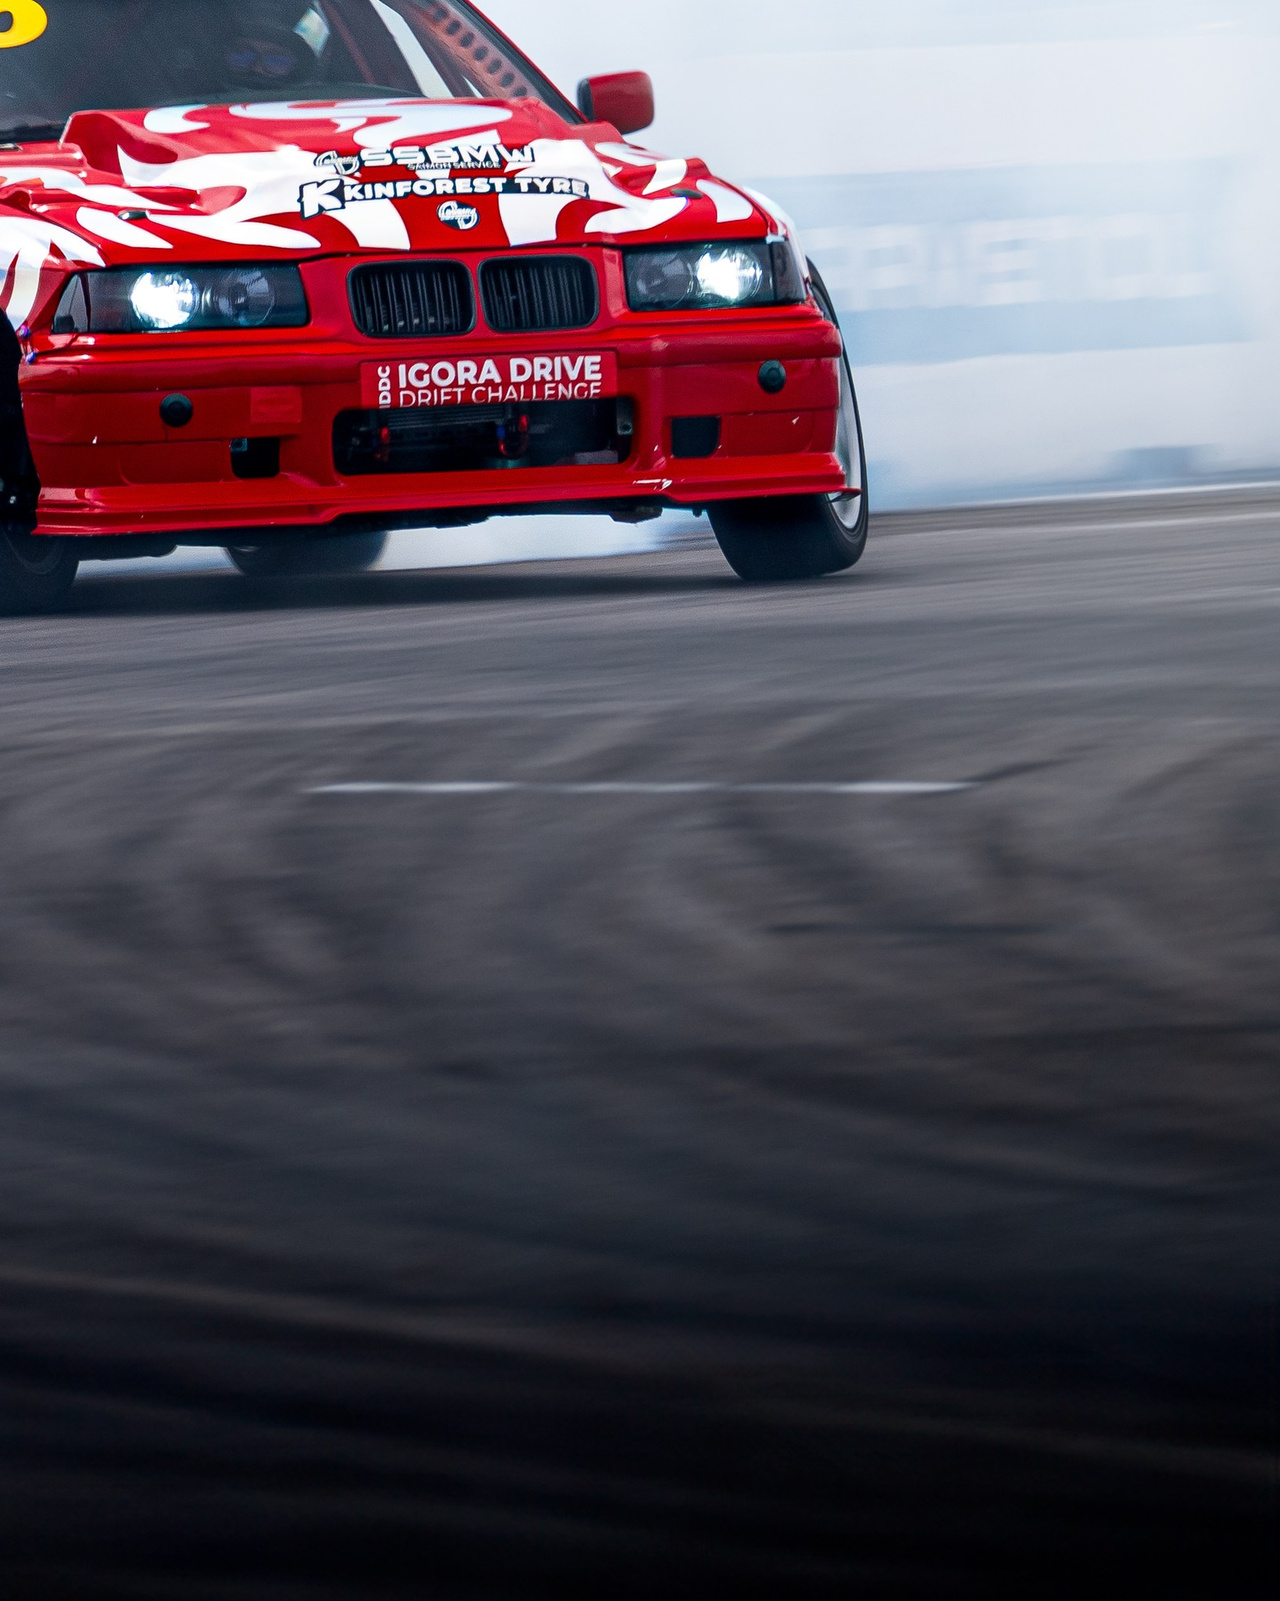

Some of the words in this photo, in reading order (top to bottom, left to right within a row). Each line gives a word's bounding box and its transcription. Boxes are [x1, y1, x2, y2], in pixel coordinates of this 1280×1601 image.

[360, 144, 535, 167] SSBMW
[452, 161, 502, 170] SERVICE
[344, 177, 507, 201] KINFOREST
[515, 177, 587, 198] TYRE
[398, 359, 502, 388] IGORA
[509, 355, 602, 383] DRIVE
[377, 365, 391, 409] IDDC
[399, 387, 466, 408] DRIFT
[471, 382, 602, 404] CHALLENGE
